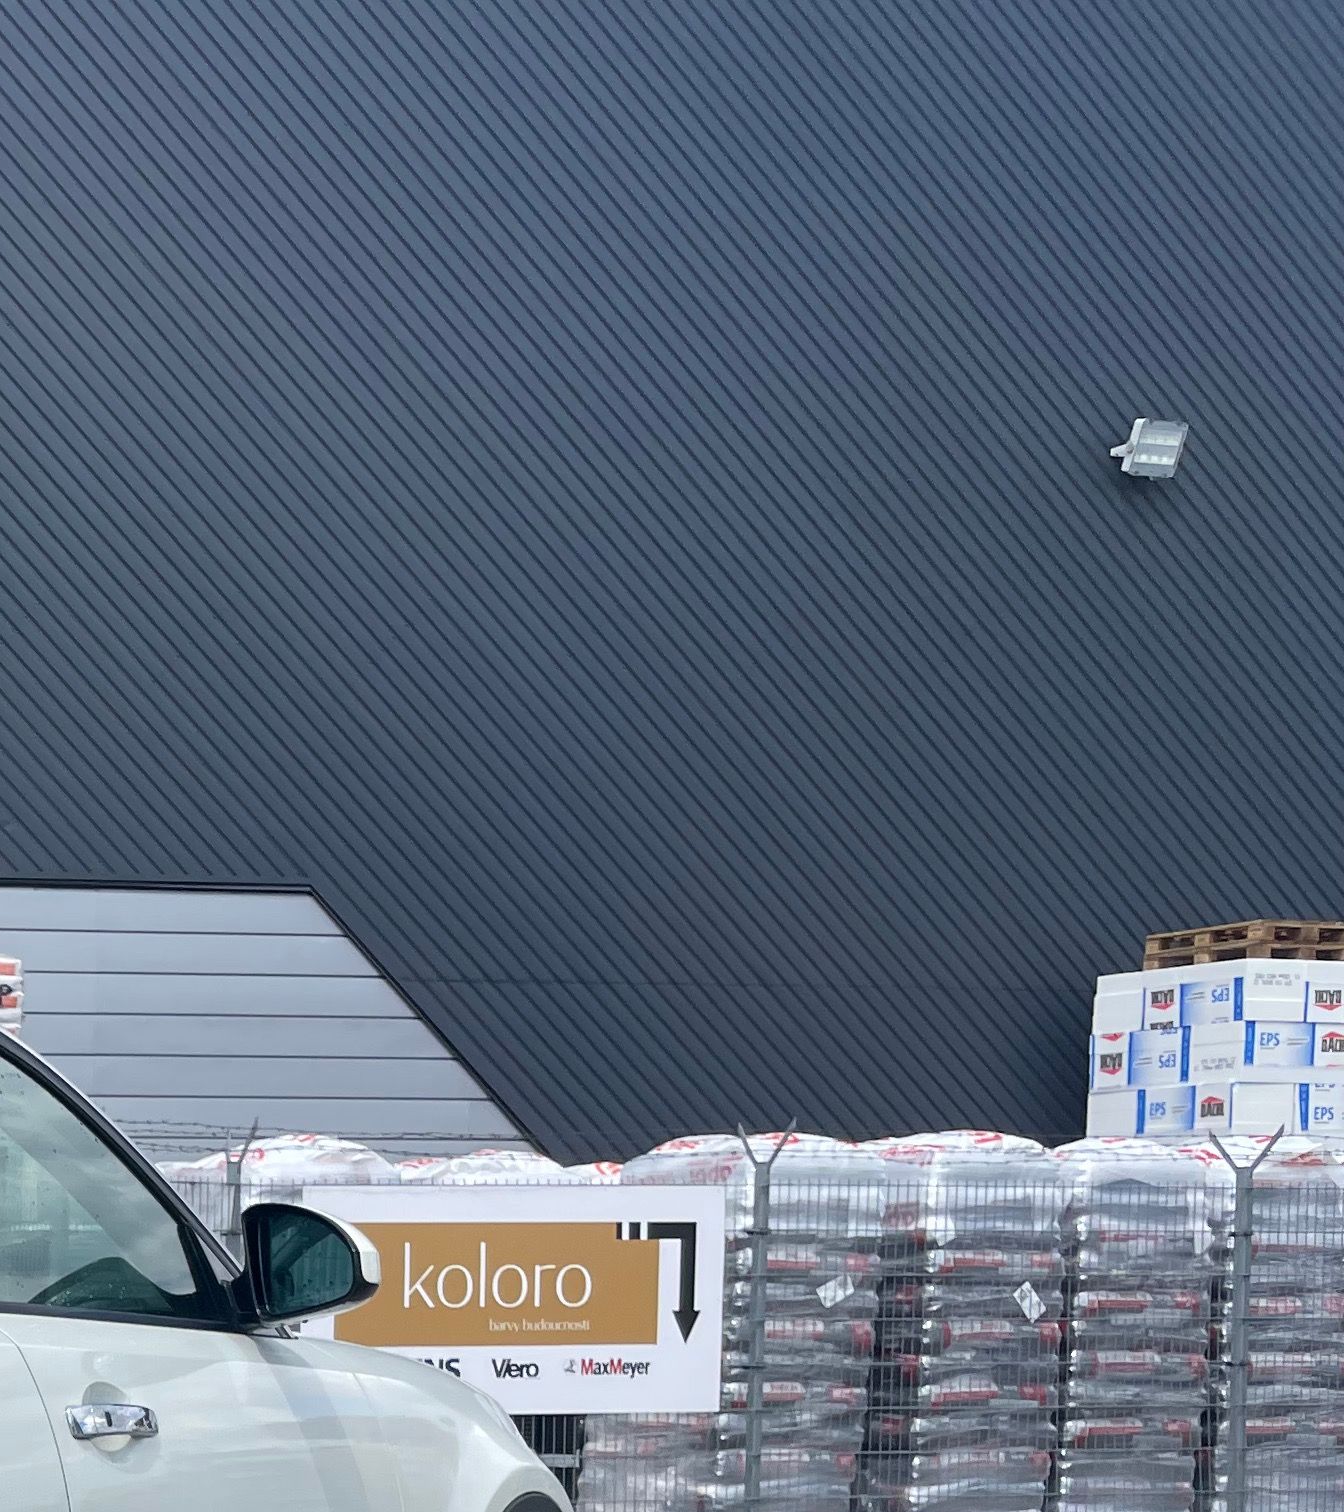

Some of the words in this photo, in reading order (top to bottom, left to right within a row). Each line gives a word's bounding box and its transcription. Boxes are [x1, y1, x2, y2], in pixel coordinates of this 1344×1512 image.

[1260, 1032, 1280, 1047] EPS
[1149, 1102, 1166, 1117] EPS
[1314, 1106, 1334, 1120] EPS
[402, 1241, 593, 1309] koloro
[489, 1318, 519, 1332] barvy
[581, 1358, 650, 1378] MaxMeyer
